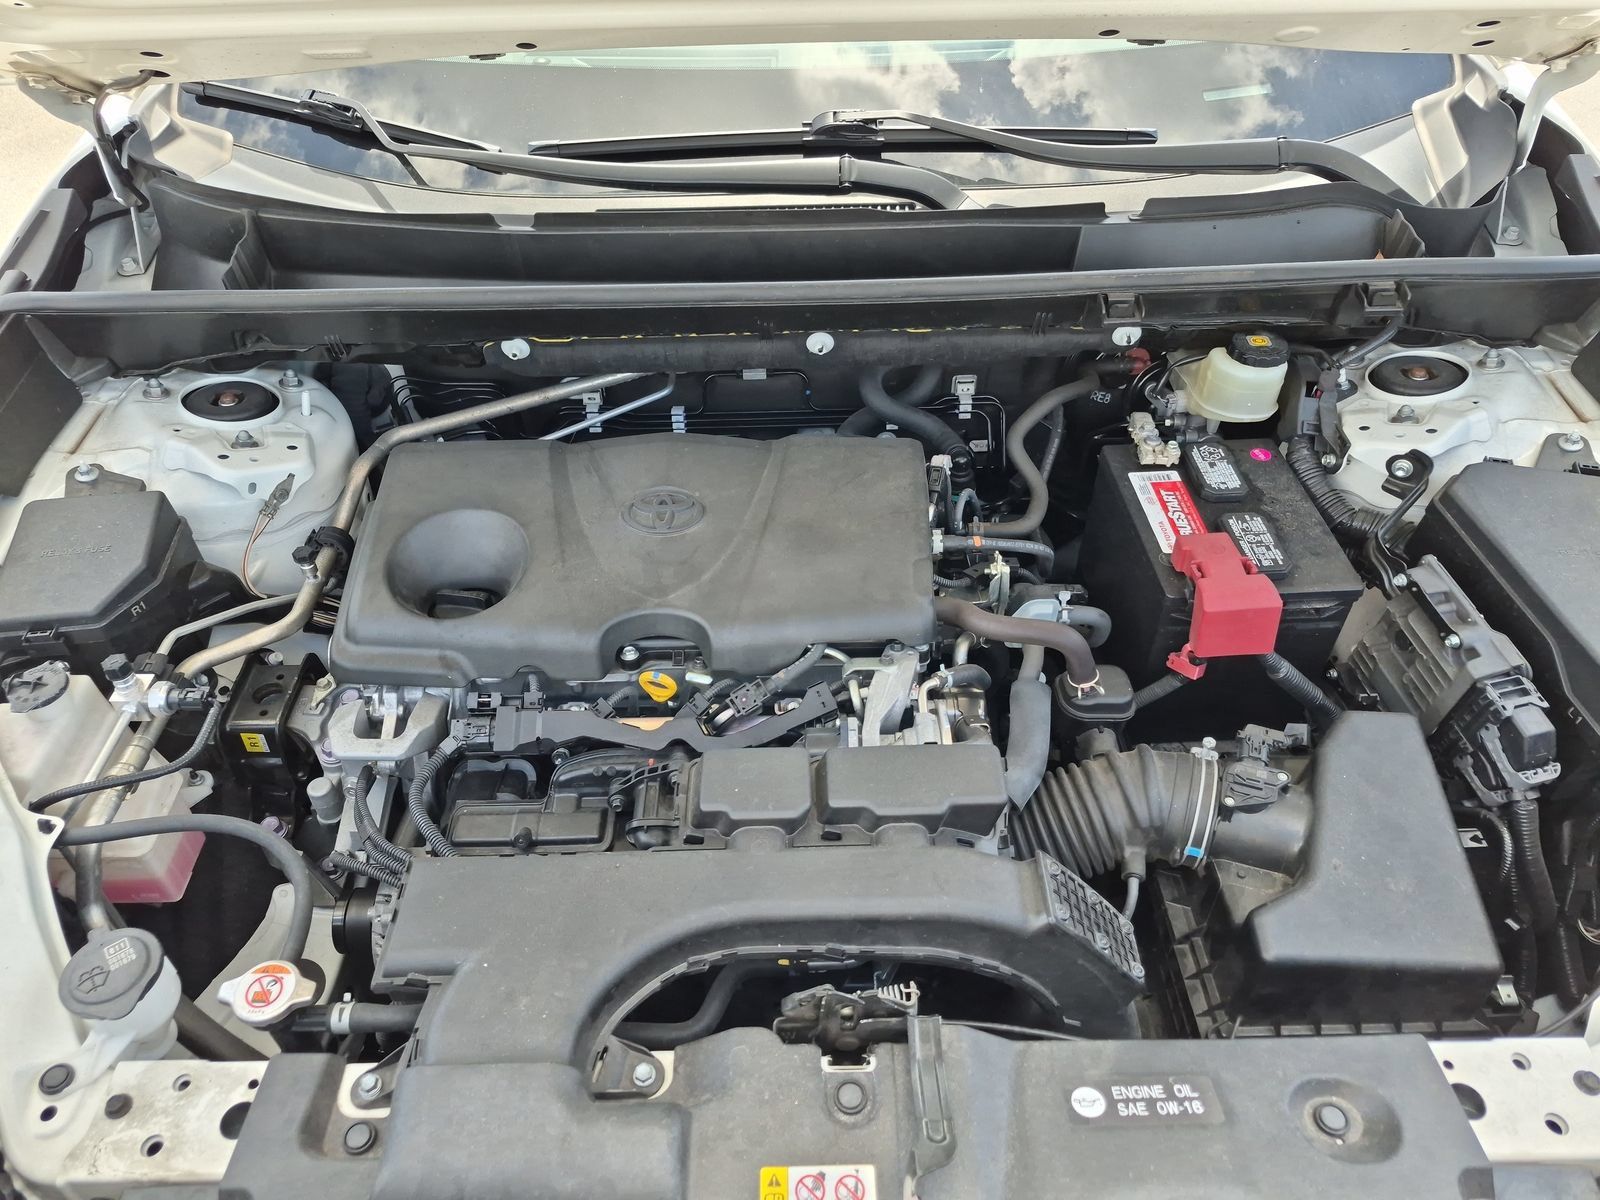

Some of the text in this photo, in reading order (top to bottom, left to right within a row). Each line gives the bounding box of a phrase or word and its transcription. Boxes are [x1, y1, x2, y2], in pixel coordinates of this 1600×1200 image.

[1090, 390, 1111, 404] RE8
[1159, 487, 1193, 536] RUESTART
[1158, 520, 1173, 543] TOYOTA
[130, 601, 147, 617] R1
[247, 736, 260, 748] R1
[1111, 1083, 1200, 1099] ENGINE OIL
[1117, 1100, 1205, 1116] SAE 0W-16
